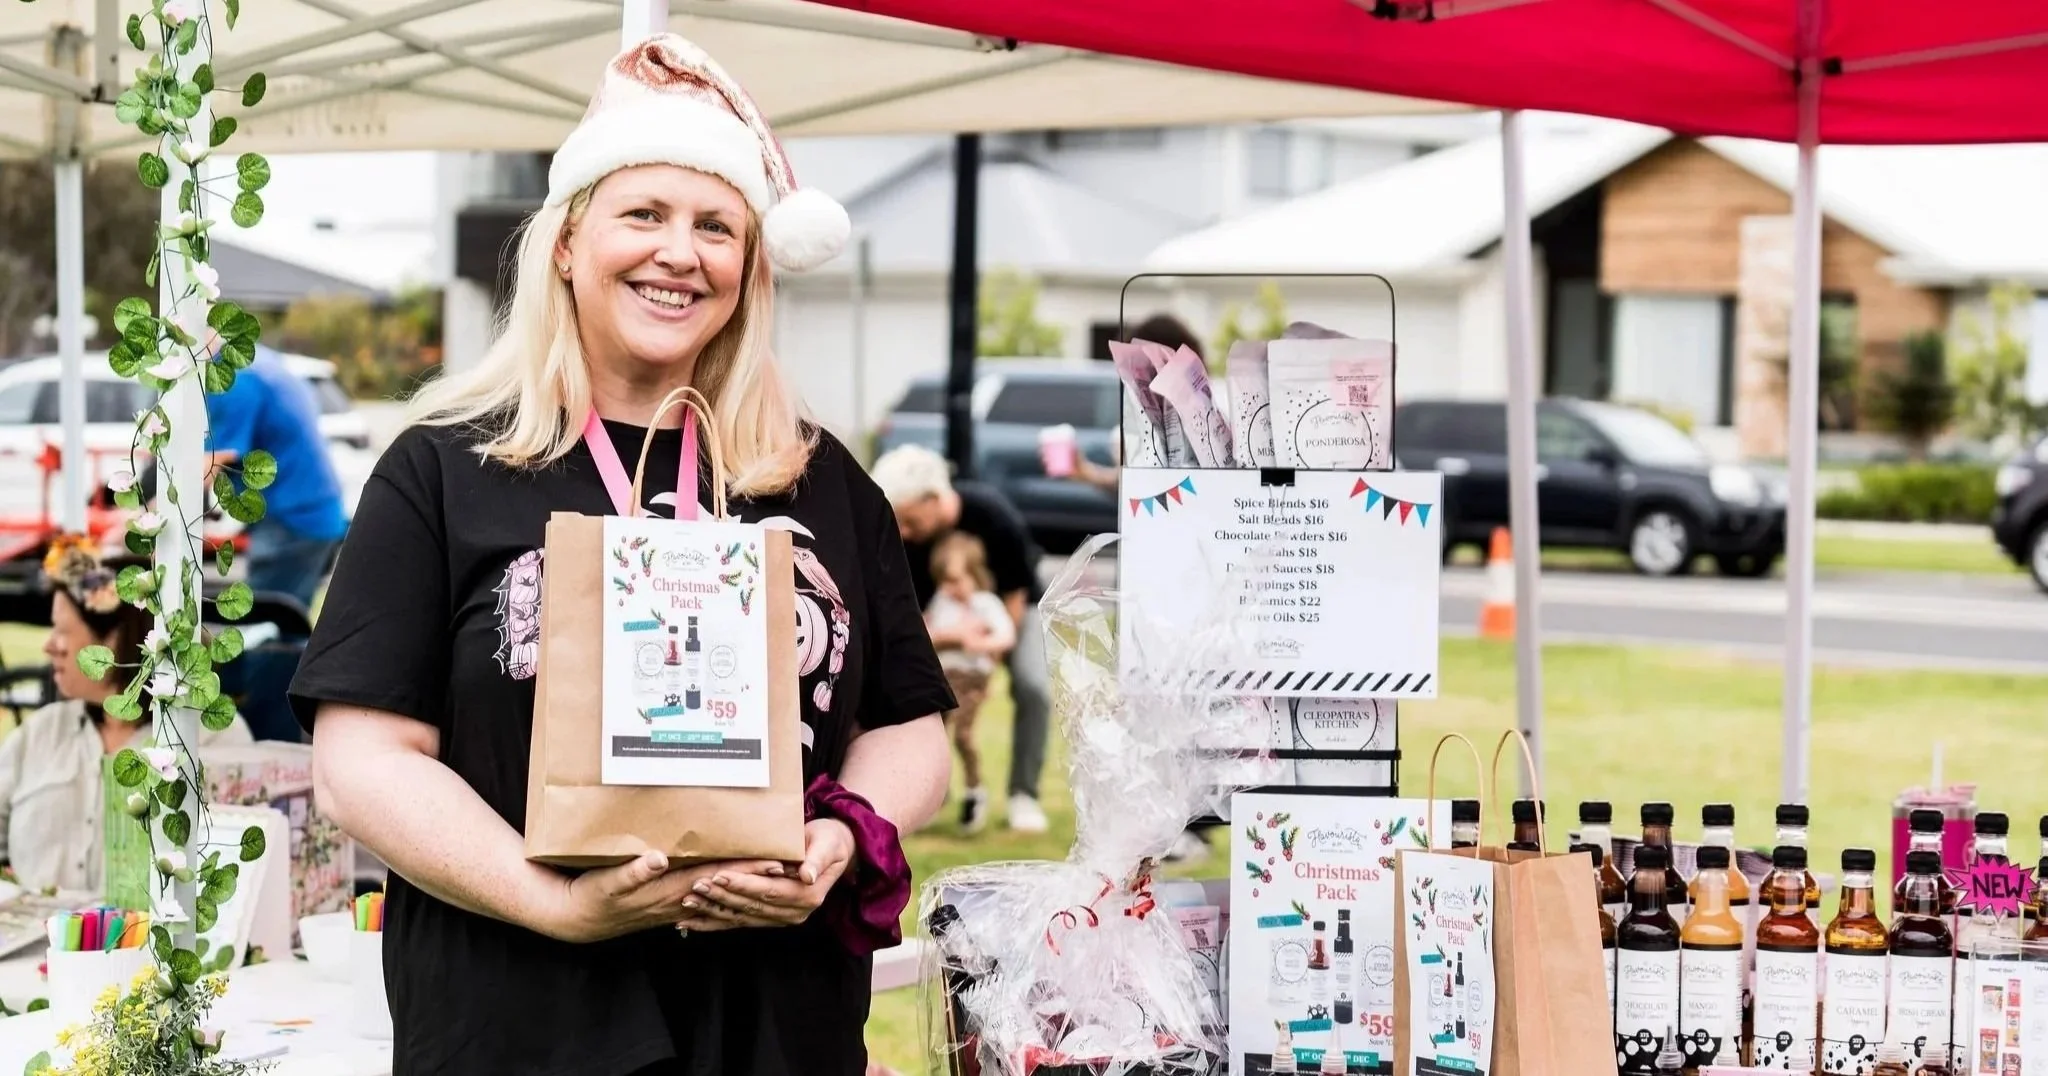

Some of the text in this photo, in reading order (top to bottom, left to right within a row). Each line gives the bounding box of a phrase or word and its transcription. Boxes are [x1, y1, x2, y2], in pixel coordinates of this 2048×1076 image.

[1305, 437, 1367, 448] PONDEROSA
[1233, 497, 1329, 510] Spice Blends $16
[1238, 514, 1325, 526] Salt Blends $16
[1214, 530, 1271, 541] Chocolate
[1327, 531, 1348, 542] $16
[1243, 546, 1318, 558] Dahs $18
[1273, 563, 1312, 574] Sauces
[1315, 563, 1336, 574] $18
[652, 577, 721, 595] Christmas
[1298, 580, 1318, 591] $18
[670, 594, 704, 610] Pack
[1239, 595, 1321, 607] Bamics $22
[1273, 611, 1295, 623] Oils
[1298, 612, 1320, 623] $25
[706, 699, 737, 719] $59
[1303, 710, 1371, 721] CLEOPATRA'S
[1314, 720, 1360, 729] KITCHEN
[1294, 861, 1380, 881] Christmas
[1315, 883, 1358, 901] Pack
[1972, 873, 2026, 899] NEW
[1435, 915, 1475, 933] Christmas
[1447, 931, 1466, 947] Pack
[1688, 1000, 1718, 1010] MANGO
[1836, 1007, 1880, 1017] CARAMEL
[1359, 1011, 1394, 1037] $59
[1467, 1030, 1482, 1051] $59
[1311, 1053, 1323, 1061] OC
[1352, 1056, 1371, 1064] DEC
